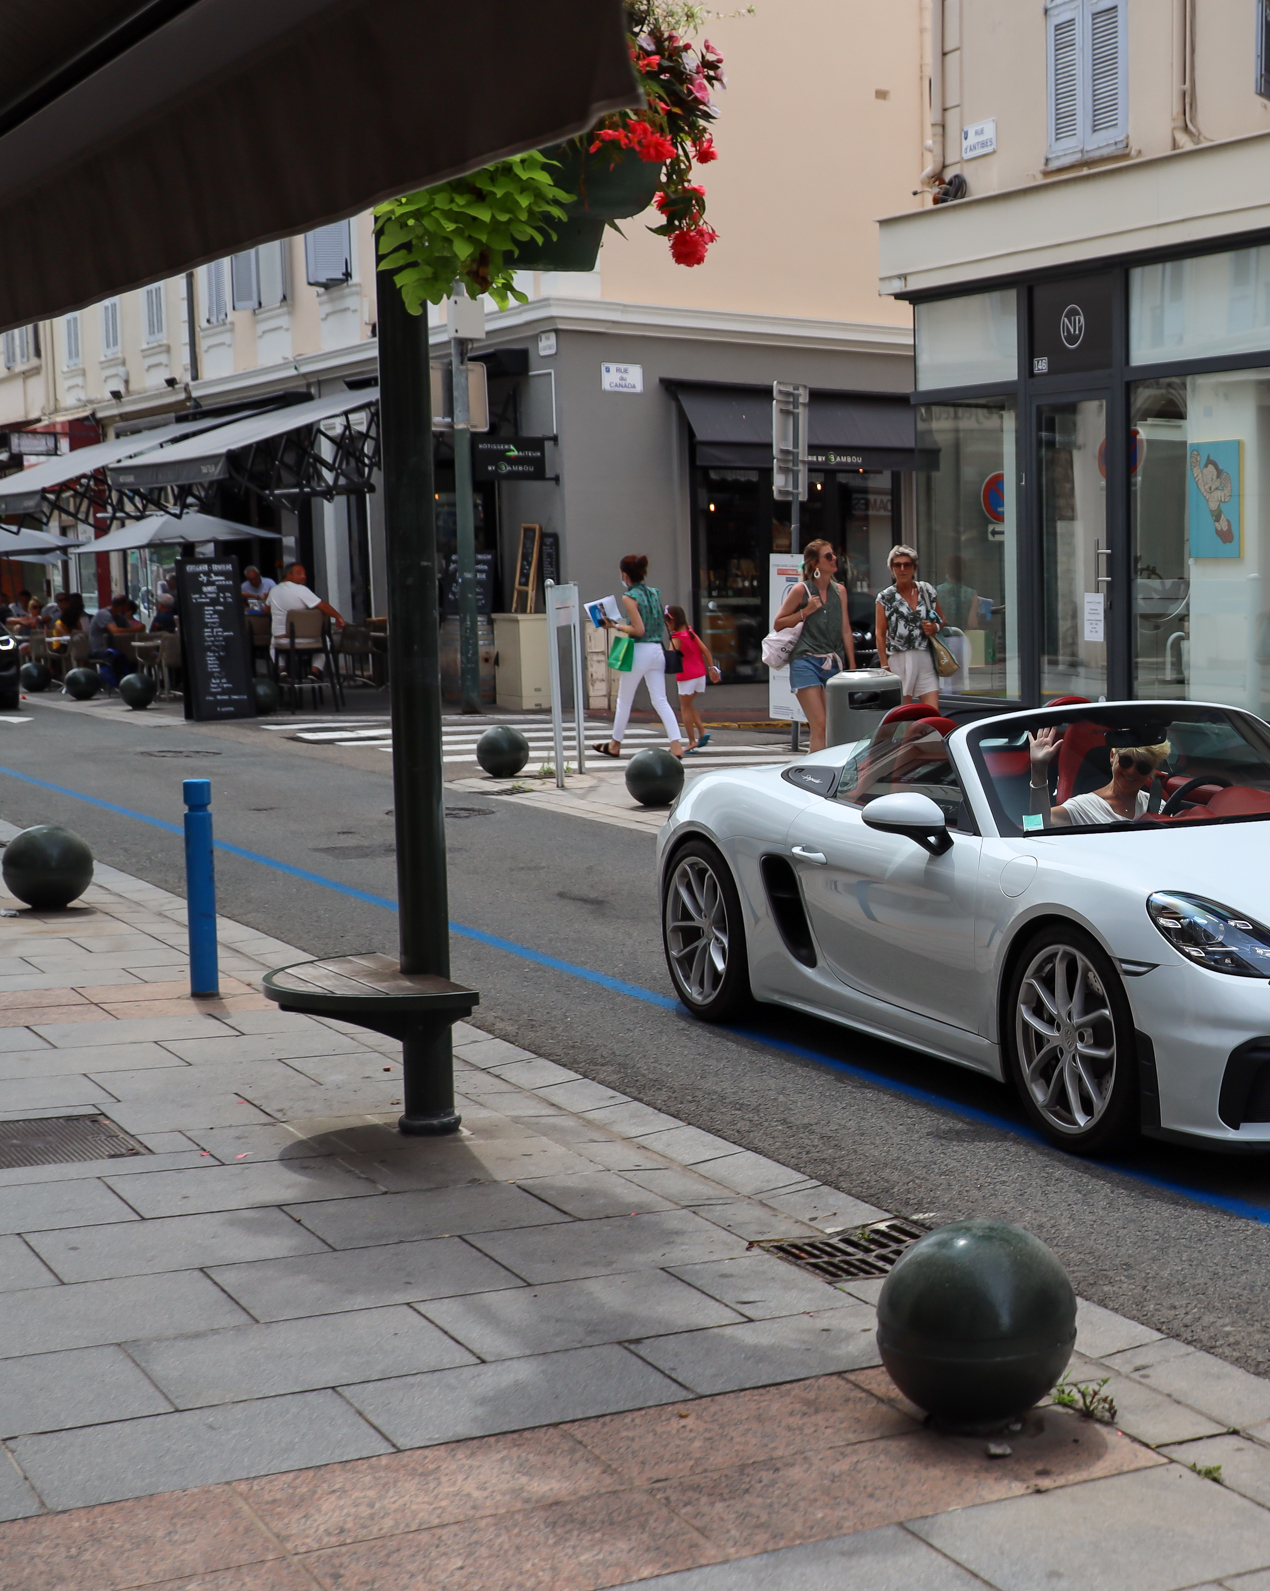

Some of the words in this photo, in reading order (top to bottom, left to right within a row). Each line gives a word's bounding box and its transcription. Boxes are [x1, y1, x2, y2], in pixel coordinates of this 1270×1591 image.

[974, 127, 985, 136] RUE
[1063, 315, 1083, 336] NP
[1034, 359, 1046, 371] 146
[609, 381, 637, 389] CANADA
